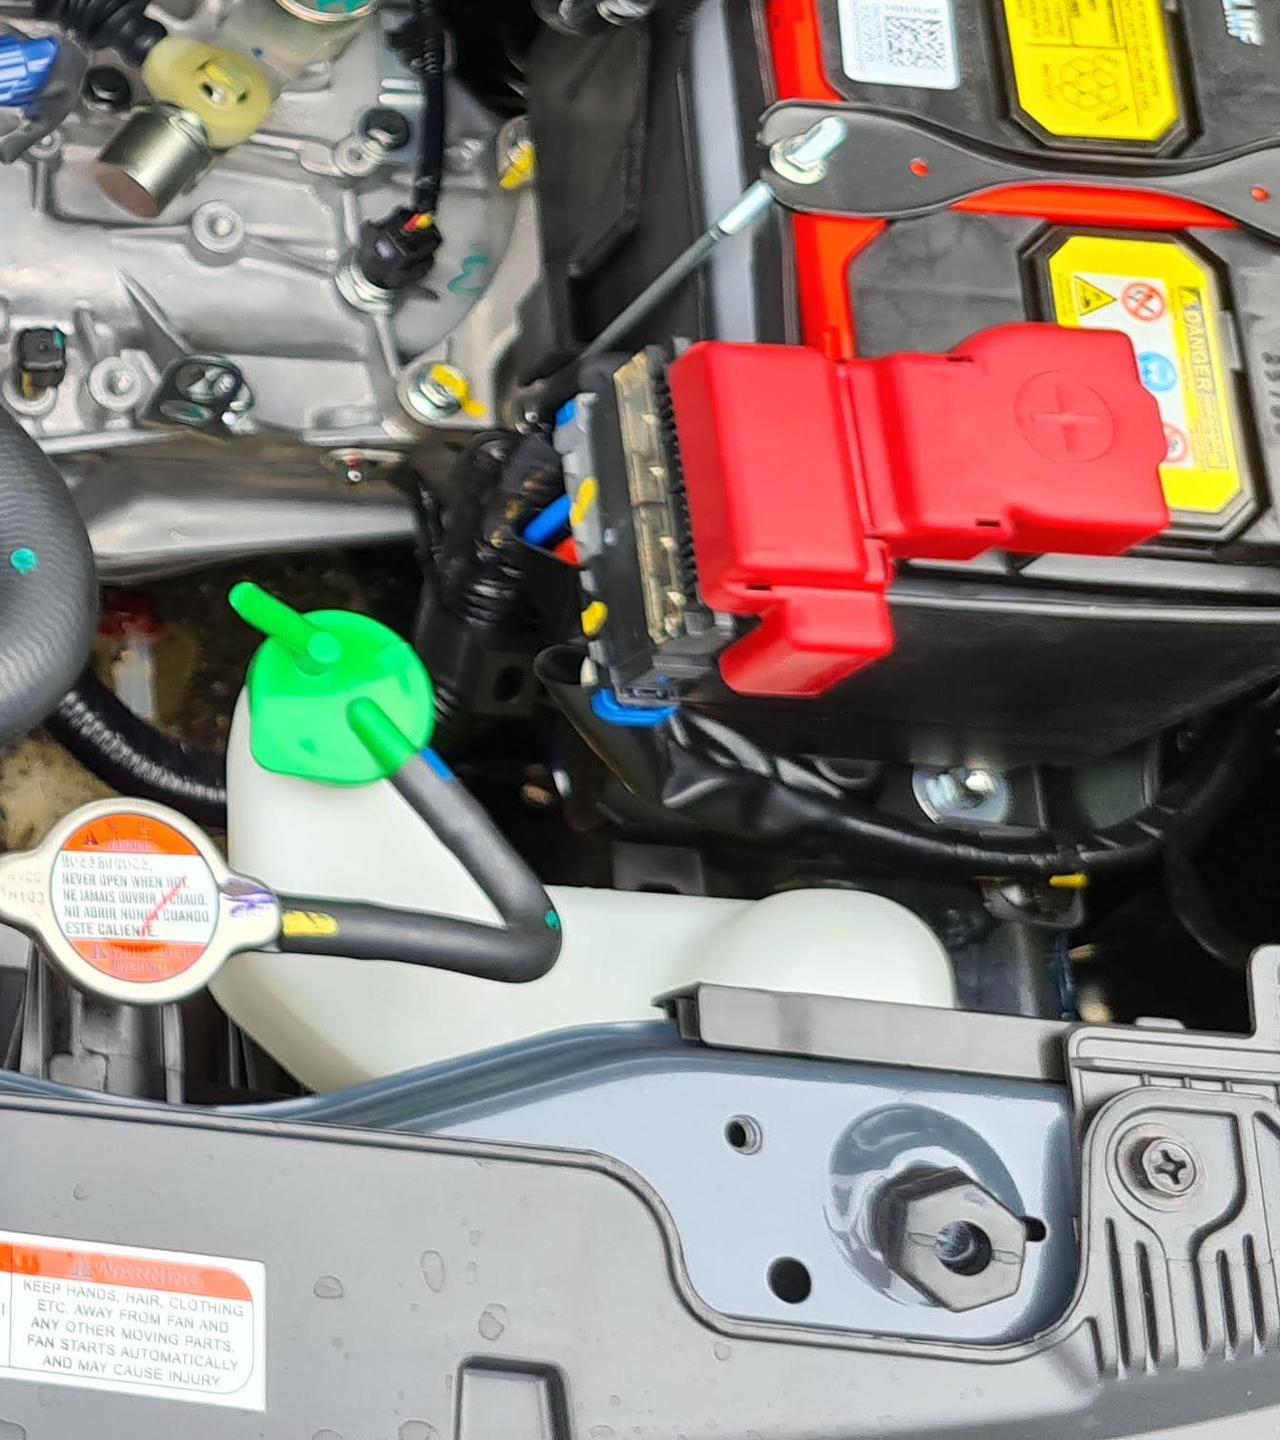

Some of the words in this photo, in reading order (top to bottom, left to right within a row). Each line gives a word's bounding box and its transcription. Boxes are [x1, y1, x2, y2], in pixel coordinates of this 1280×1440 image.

[1186, 309, 1213, 392] DANGER
[62, 872, 96, 886] NEVER
[100, 873, 128, 887] OPEN
[131, 875, 163, 889] WHEN
[63, 889, 76, 902] NE
[79, 890, 116, 904] JAMAIS
[118, 892, 156, 905] OUVRIR
[64, 905, 80, 918] NO
[83, 906, 116, 920] ABRIR
[162, 909, 209, 923] CUANDO
[65, 922, 94, 935] ESTE
[99, 1260, 204, 1289] WARNING
[23, 1278, 61, 1293] KEEP
[66, 1285, 120, 1304] HANDS,
[125, 1291, 163, 1310] HAIR,
[169, 1296, 244, 1318] CLOTHING
[37, 1298, 66, 1314] ETC.
[74, 1303, 114, 1320] AWAY
[119, 1308, 161, 1326] FROM
[167, 1314, 194, 1330] FAN
[199, 1319, 229, 1334] AND
[31, 1315, 59, 1331] ANY
[65, 1320, 116, 1338] OTHER
[121, 1326, 179, 1347] MOVING
[185, 1333, 235, 1354] PARTS.
[27, 1334, 54, 1349] FAN
[60, 1337, 116, 1357] STARTS
[120, 1345, 238, 1372] AUTOMATICALLY
[42, 1354, 72, 1370] AND
[78, 1359, 109, 1374] MAY
[113, 1363, 163, 1382] CAUSE
